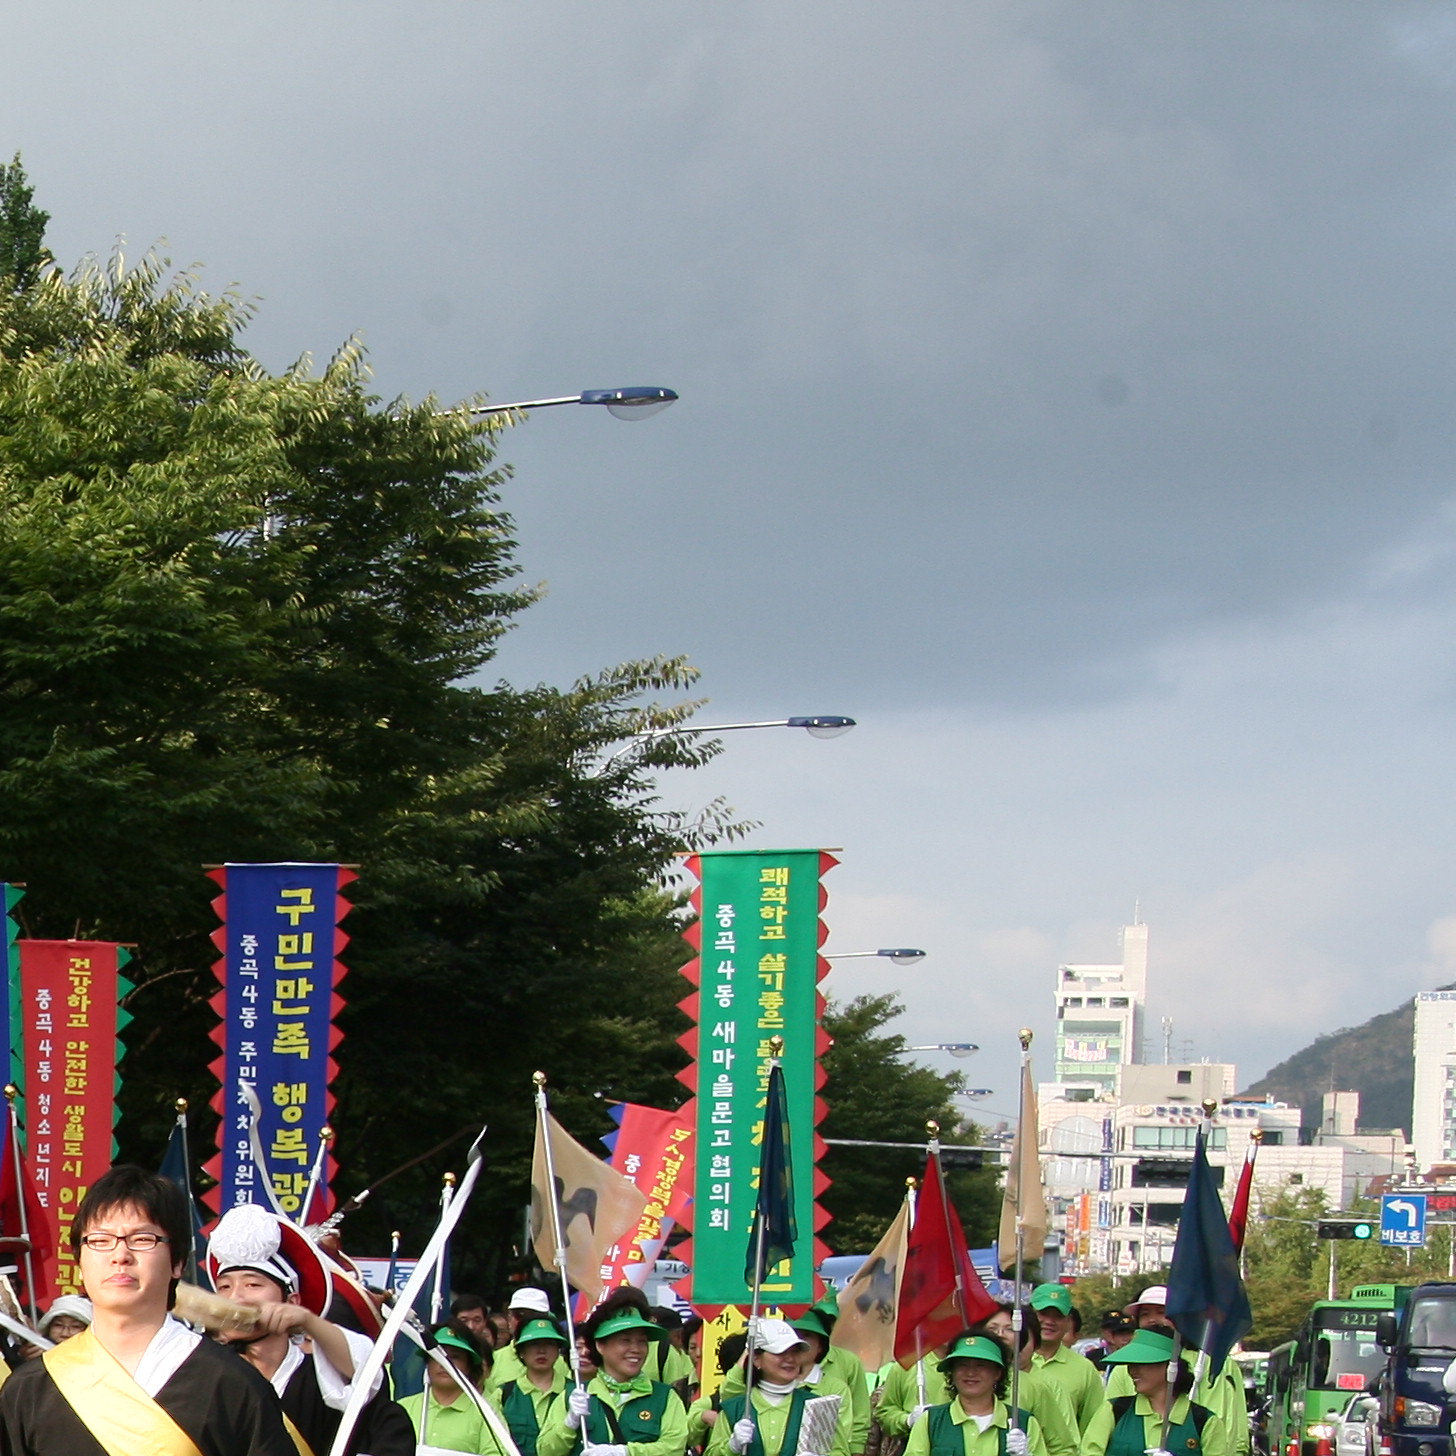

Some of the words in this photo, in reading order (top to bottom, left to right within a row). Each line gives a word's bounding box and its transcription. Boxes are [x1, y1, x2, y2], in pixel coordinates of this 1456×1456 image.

[759, 867, 789, 940] 쾌적하고
[66, 958, 92, 1028] 건강하고
[239, 934, 258, 1029] 중곡4동
[272, 888, 315, 1060] 구민만족
[714, 904, 735, 1008] 중곡4동
[757, 953, 786, 1029] 살기좋은
[35, 989, 53, 1082] 중곡4동
[64, 1041, 89, 1095] 안전한
[62, 1105, 85, 1178] 생활도시
[271, 1083, 309, 1226] 행복광
[709, 1021, 735, 1231] 새마을문고협의회
[1382, 1228, 1421, 1243] 비보호
[1340, 1313, 1377, 1325] 4212
